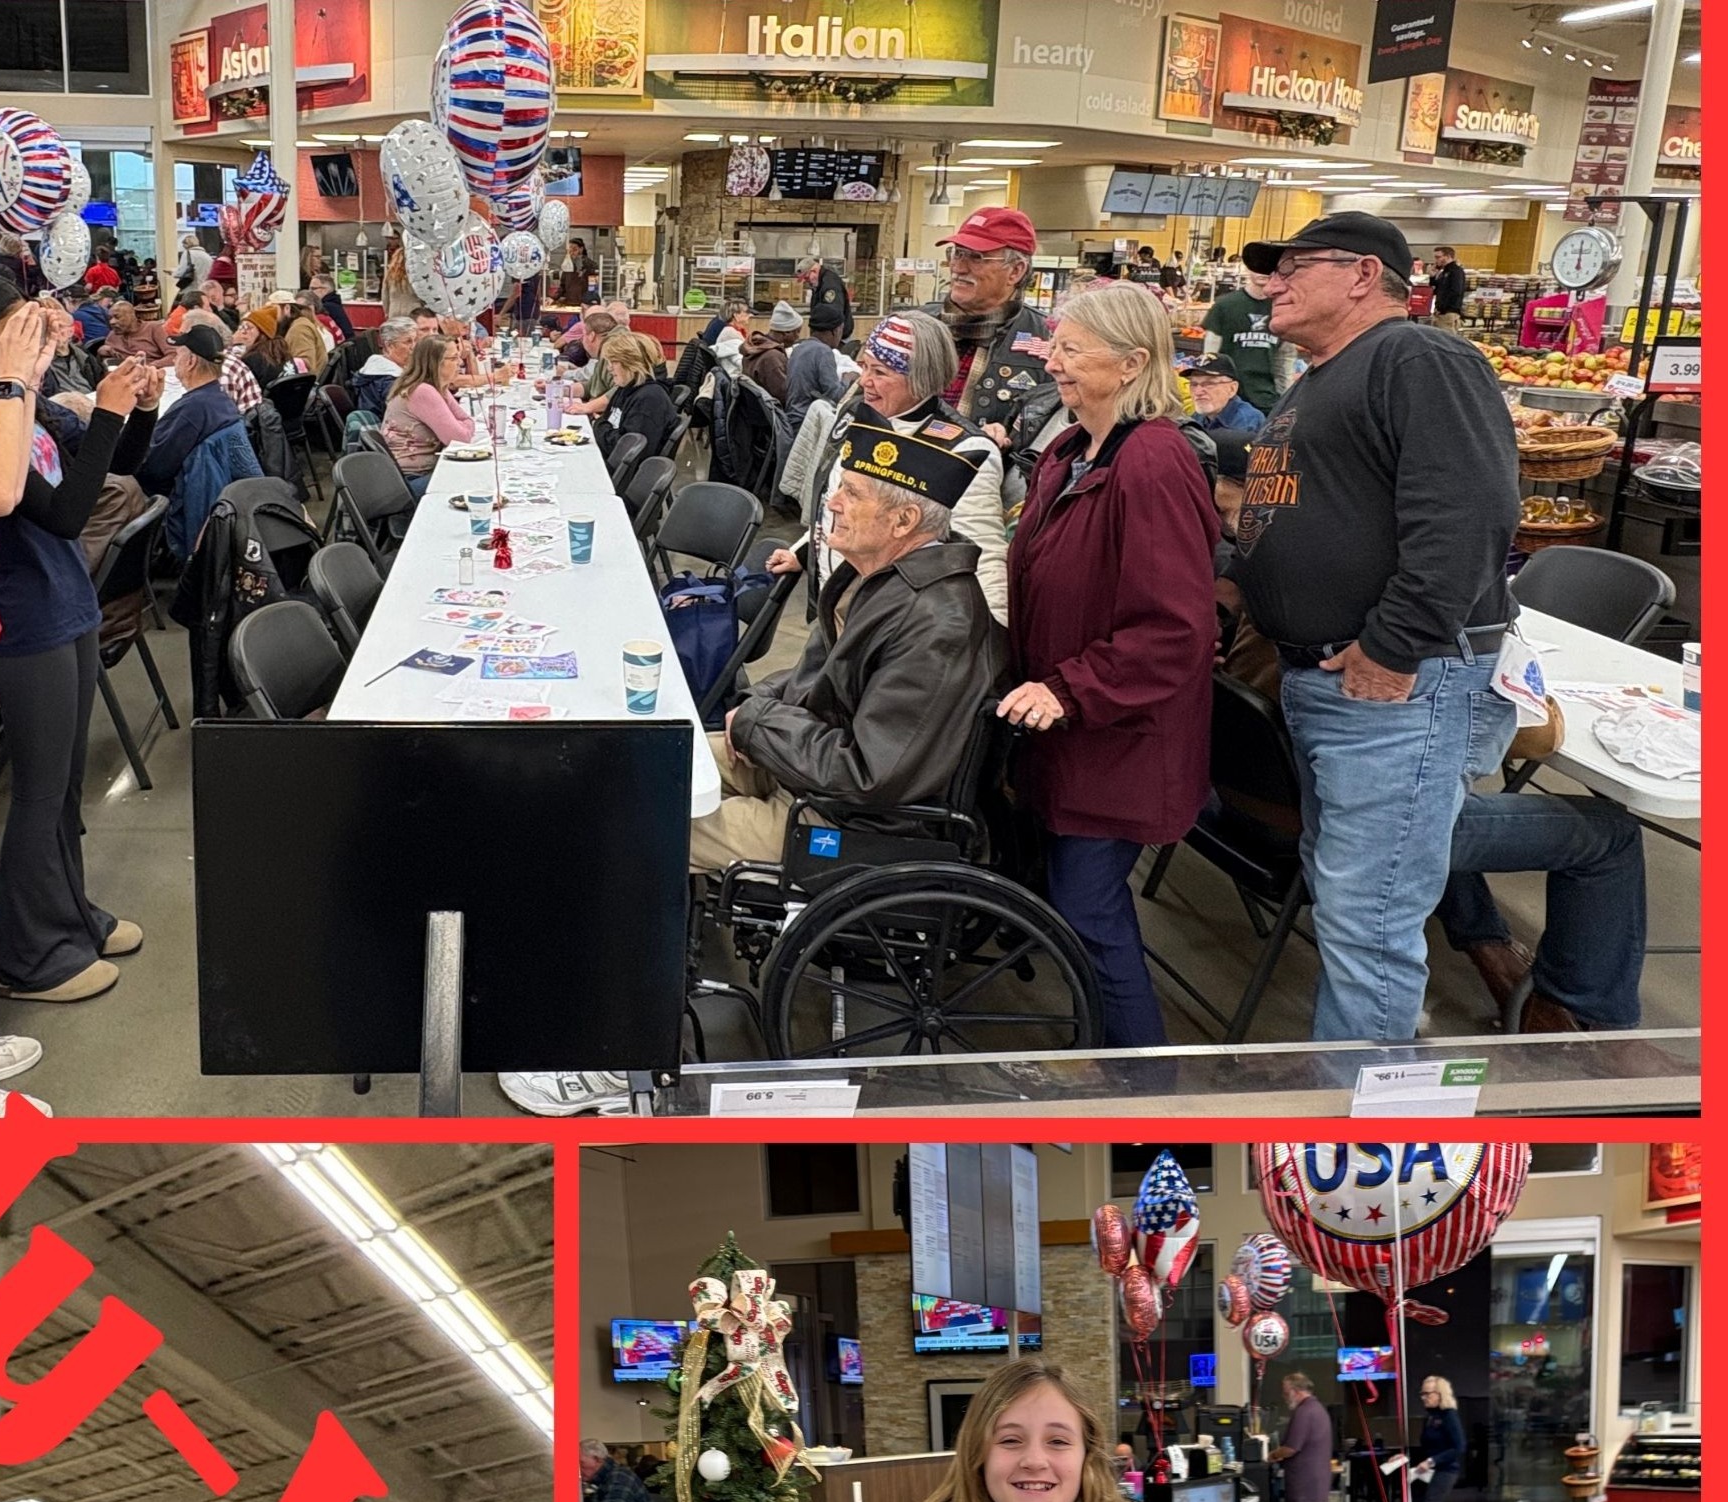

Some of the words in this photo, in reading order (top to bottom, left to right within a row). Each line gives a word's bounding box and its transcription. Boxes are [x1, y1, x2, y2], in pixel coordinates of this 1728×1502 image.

[1284, 0, 1343, 34] broiled
[1390, 15, 1435, 33] Guaranteed
[746, 14, 905, 62] Italian
[1012, 36, 1095, 74] hearty
[1251, 65, 1332, 110] Hickory
[1587, 95, 1615, 103] DAILY
[1085, 91, 1113, 112] cold
[1113, 93, 1154, 116] salads
[1669, 362, 1701, 377] 3.99
[853, 456, 915, 491] SPRINGFIELD,
[916, 479, 928, 493] IL
[746, 1091, 774, 1101] 5.99
[1302, 1143, 1450, 1193] USA
[1254, 1334, 1278, 1348] USA
